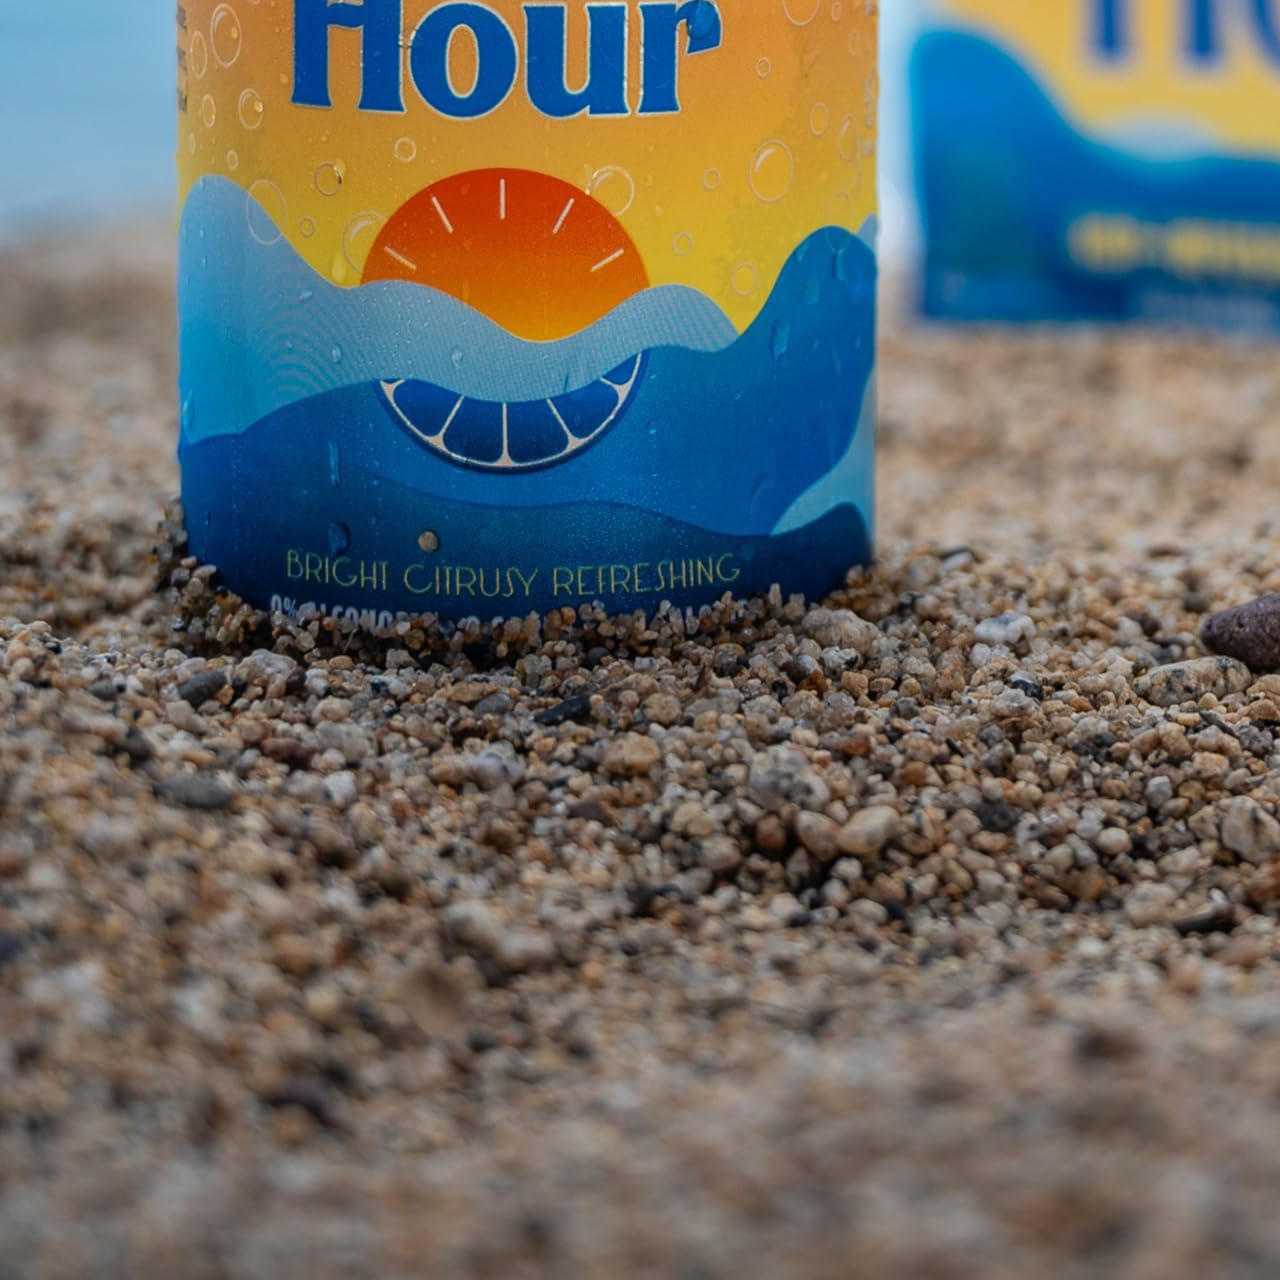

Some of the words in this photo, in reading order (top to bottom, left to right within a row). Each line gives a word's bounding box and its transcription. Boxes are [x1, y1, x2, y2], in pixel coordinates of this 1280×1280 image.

[286, 549, 389, 591] BRIGHT
[402, 563, 538, 598] CITRUSY
[552, 552, 741, 598] REFRESHING
